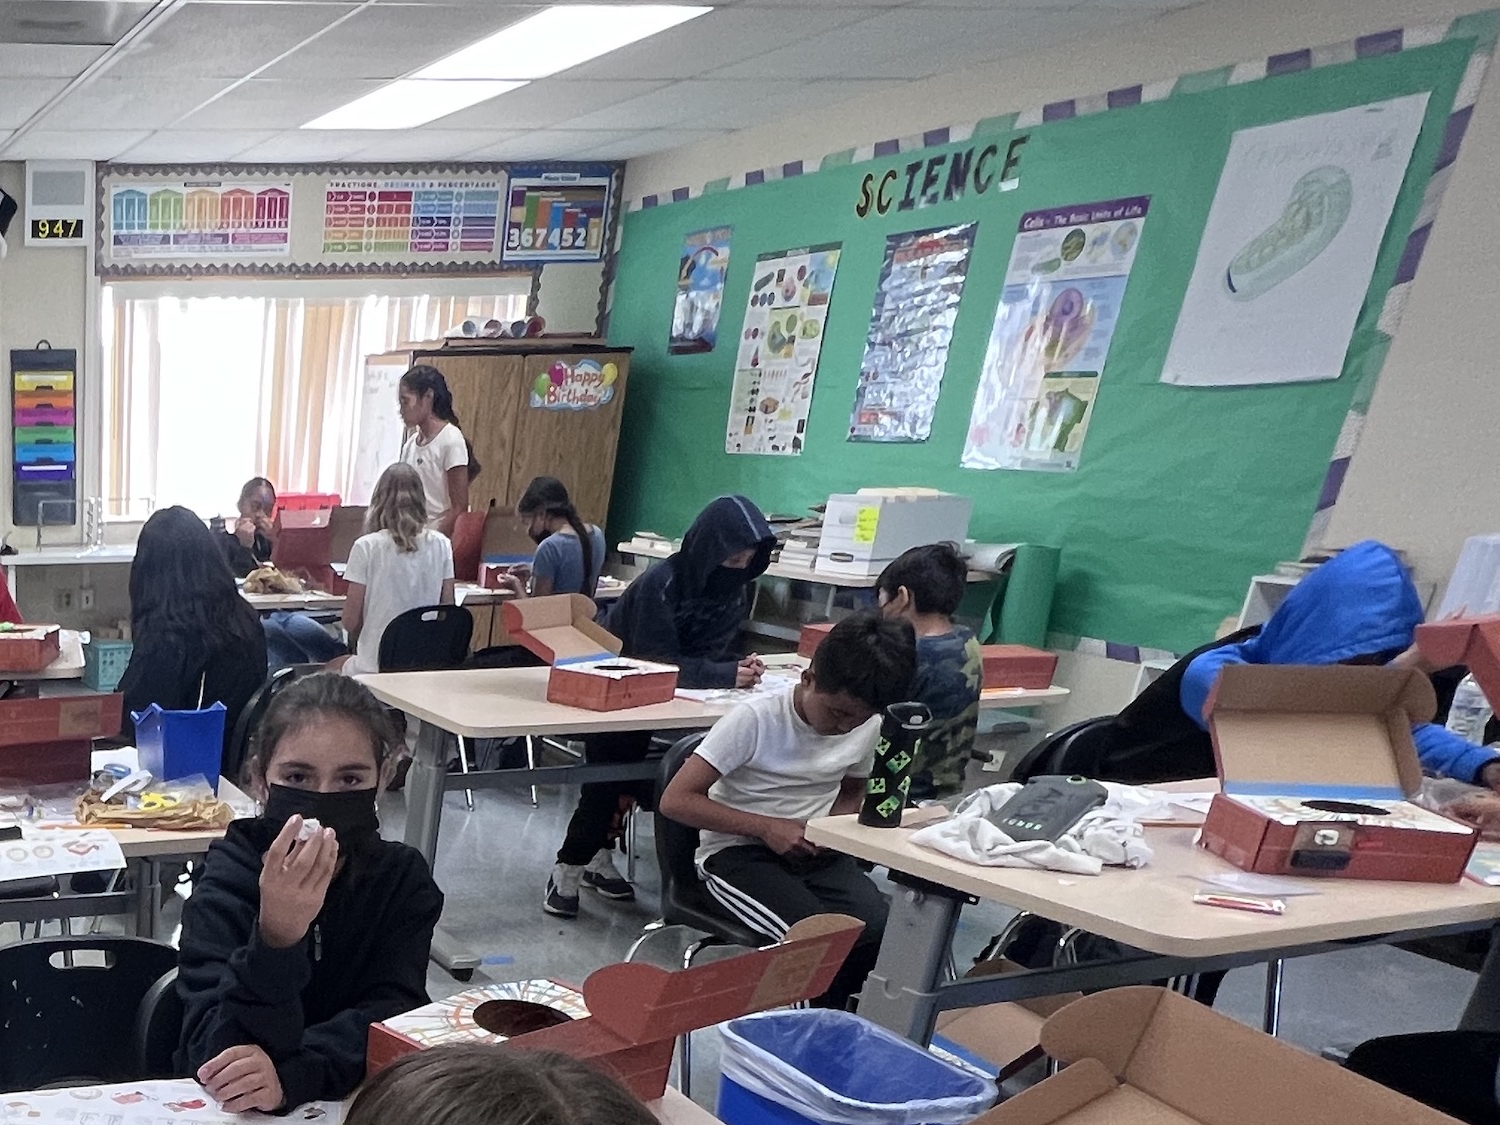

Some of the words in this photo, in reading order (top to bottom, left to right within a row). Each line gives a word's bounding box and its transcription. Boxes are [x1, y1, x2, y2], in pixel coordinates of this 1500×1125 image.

[856, 135, 1031, 218] SCIENCE
[564, 367, 606, 389] Happy
[546, 382, 601, 405] Birthday
